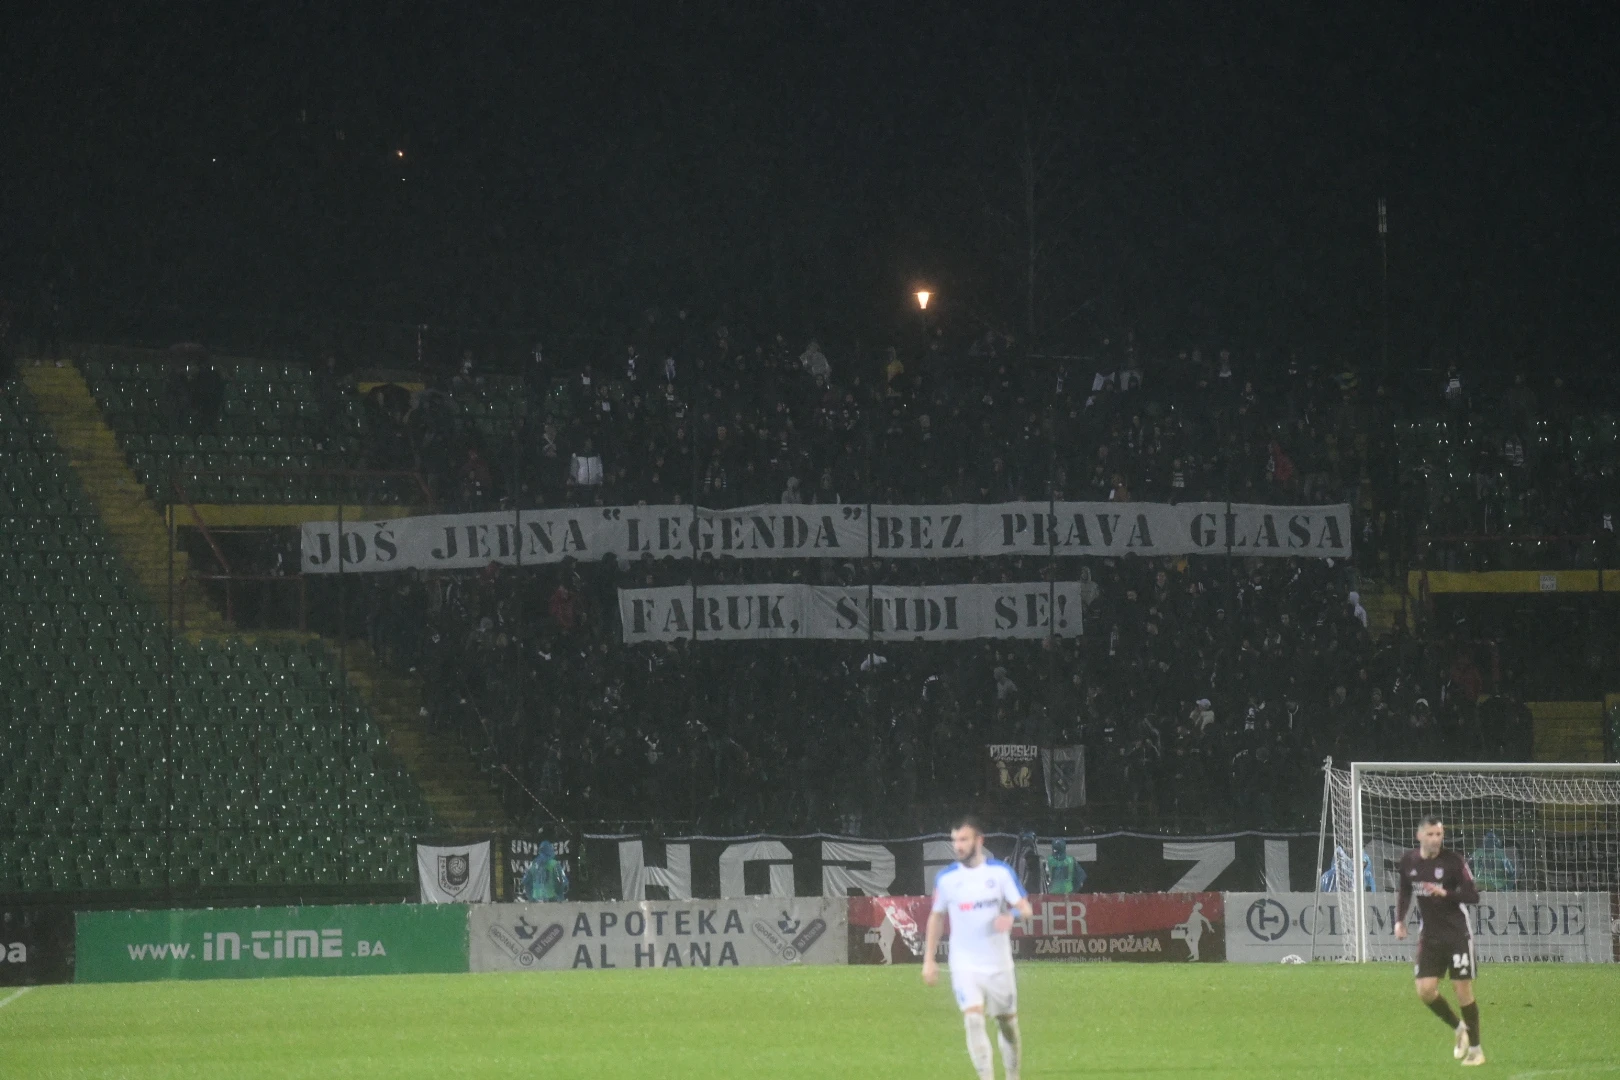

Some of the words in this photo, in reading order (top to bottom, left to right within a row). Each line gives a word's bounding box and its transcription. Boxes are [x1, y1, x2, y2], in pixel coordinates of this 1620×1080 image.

[309, 522, 397, 565] JOŠ
[431, 519, 588, 560] JEDNA
[877, 514, 964, 549] BEZ
[1001, 513, 1154, 547] PRAVA
[1190, 513, 1345, 549] GLASA
[631, 595, 800, 634] FARUK,
[836, 596, 960, 632] STIDI
[994, 592, 1068, 630] SE!
[571, 909, 745, 938] APOTEKA
[571, 943, 617, 969] AL
[633, 941, 740, 969] HANA
[1035, 935, 1085, 954] ZAŠTITA
[1088, 938, 1107, 953] OD
[1109, 934, 1162, 953] POŽARA
[1452, 953, 1470, 969] 24
